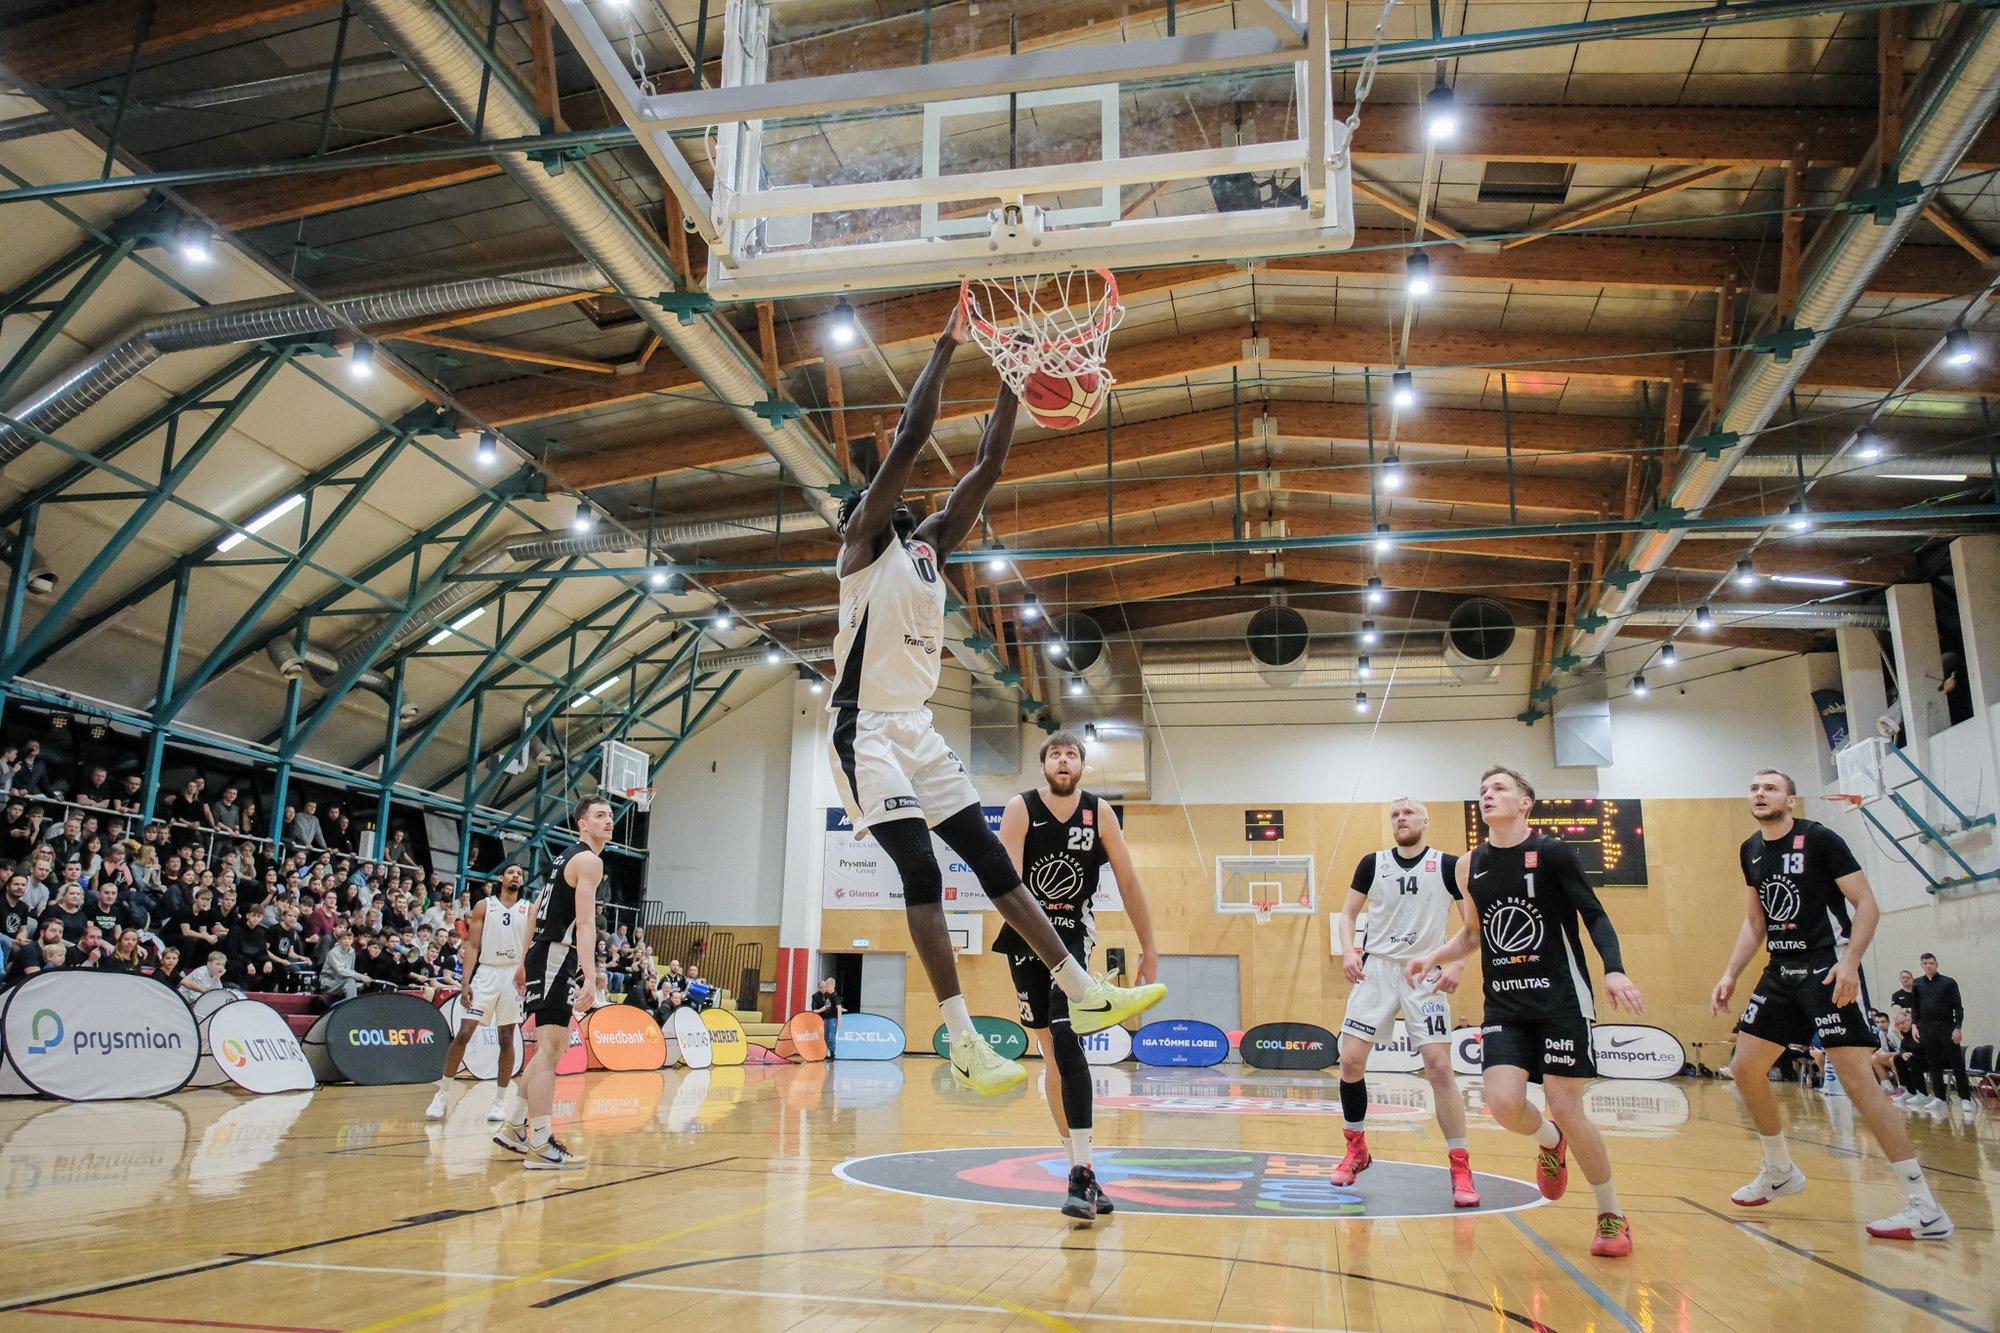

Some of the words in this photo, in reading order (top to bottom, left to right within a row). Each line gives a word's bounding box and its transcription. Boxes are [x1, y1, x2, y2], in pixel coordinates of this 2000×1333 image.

[1067, 827, 1094, 851] 23
[840, 859, 876, 869] Prysmian
[1031, 853, 1055, 872] KEILA
[1059, 851, 1084, 877] BASKET
[1781, 852, 1805, 874] 13
[856, 867, 876, 876] Group
[1396, 876, 1418, 895] 14
[1523, 873, 1535, 898] 1
[1772, 874, 1799, 894] BASKET
[849, 889, 880, 898] Glamox
[1482, 899, 1503, 925] KEILA
[1507, 896, 1543, 920] BASKET
[503, 912, 511, 926] 3
[1049, 916, 1075, 929] LITAS
[1492, 955, 1529, 967] COOLBET
[1502, 978, 1551, 991] UTILITAS
[1424, 1015, 1447, 1036] 14
[1815, 1012, 1841, 1027] Delfi
[348, 1028, 417, 1046] COOLBET
[594, 1029, 646, 1045] Swedbank
[709, 1030, 739, 1043] AMIRENT
[836, 1031, 898, 1042] LEXELA
[1825, 1025, 1847, 1035] Daily
[73, 1026, 181, 1055] prysmian
[1083, 1032, 1109, 1051] lfi
[1142, 1038, 1158, 1047] IGA
[1158, 1037, 1191, 1047] TÕMME
[1256, 1040, 1308, 1050] COOLBET
[1545, 1038, 1574, 1051] Delfi
[1552, 1055, 1576, 1067] Daily
[1594, 1049, 1676, 1063] eamsport.ee
